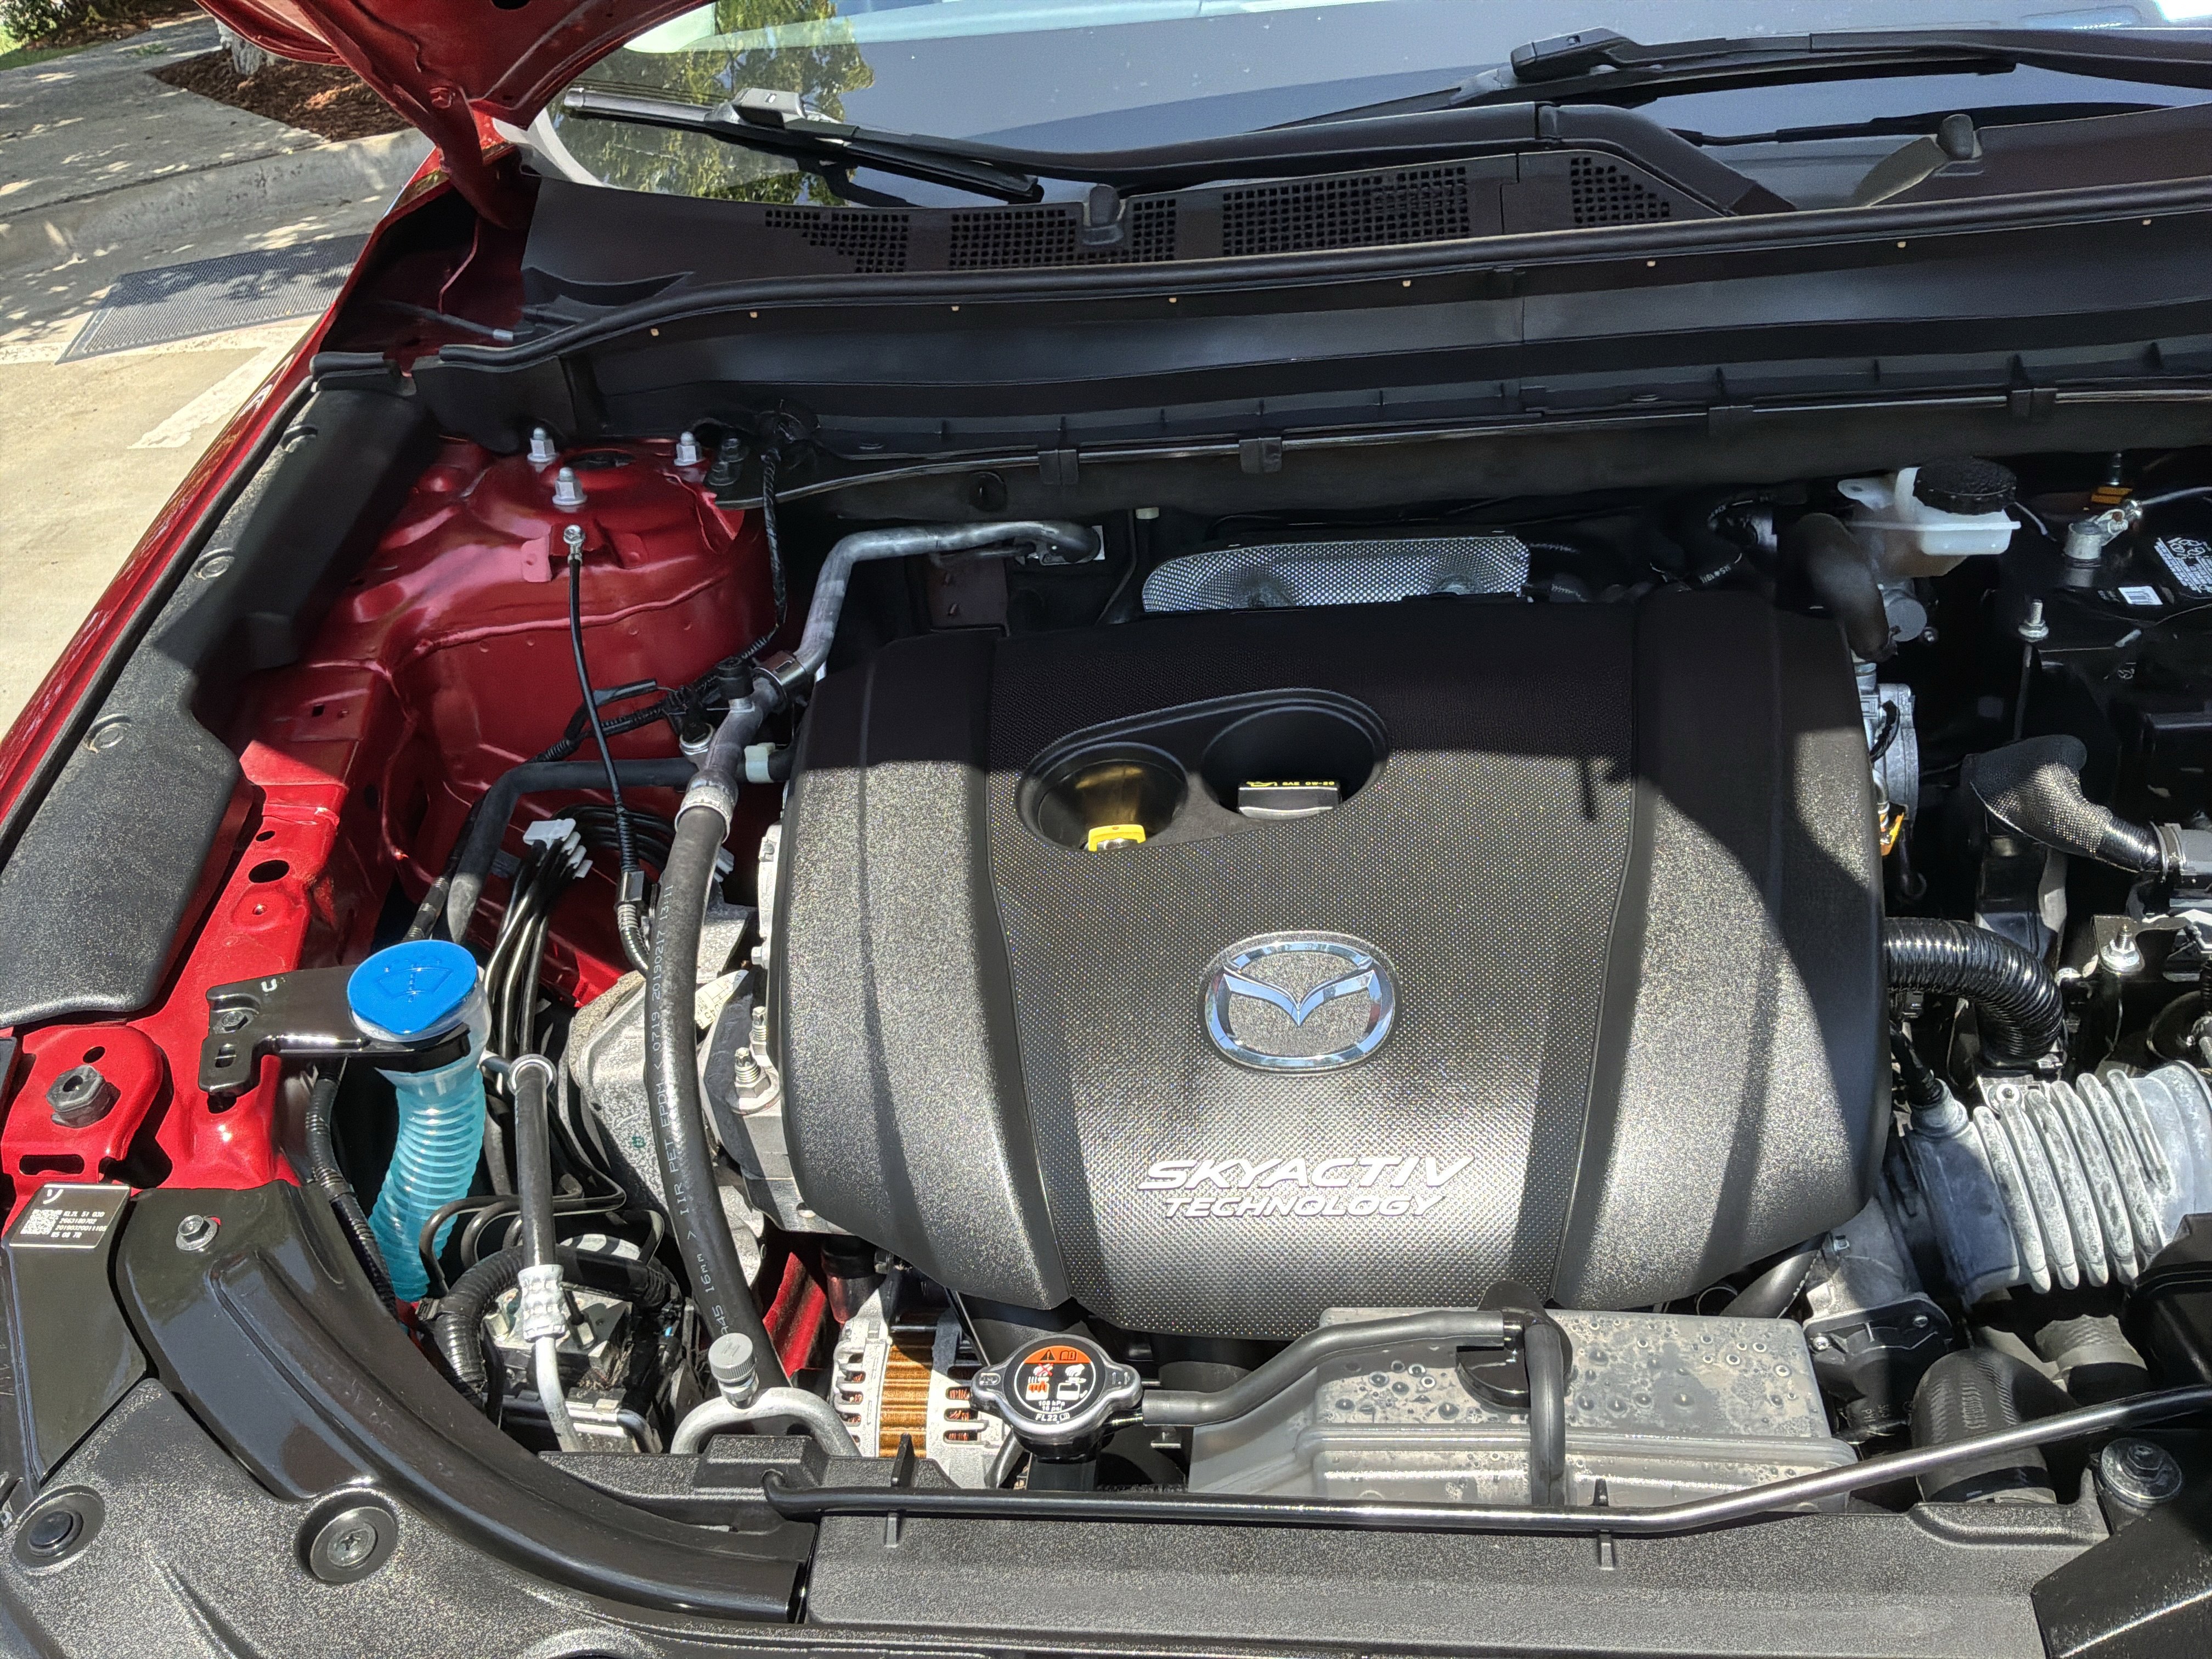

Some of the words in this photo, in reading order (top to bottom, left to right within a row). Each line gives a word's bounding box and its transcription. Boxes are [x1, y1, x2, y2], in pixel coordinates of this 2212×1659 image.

[659, 884, 674, 920] 13:11
[652, 930, 667, 1001] 20190217
[651, 1011, 662, 1052] 0719
[655, 1082, 670, 1127] EPDM
[664, 1139, 679, 1173] PET
[1138, 1156, 1475, 1190] SKYACTIV
[674, 1182, 690, 1215] IIR
[1165, 1195, 1446, 1218] TECHNOLOGY
[697, 1254, 715, 1293] 16mm
[1035, 1413, 1058, 1422] FL22
